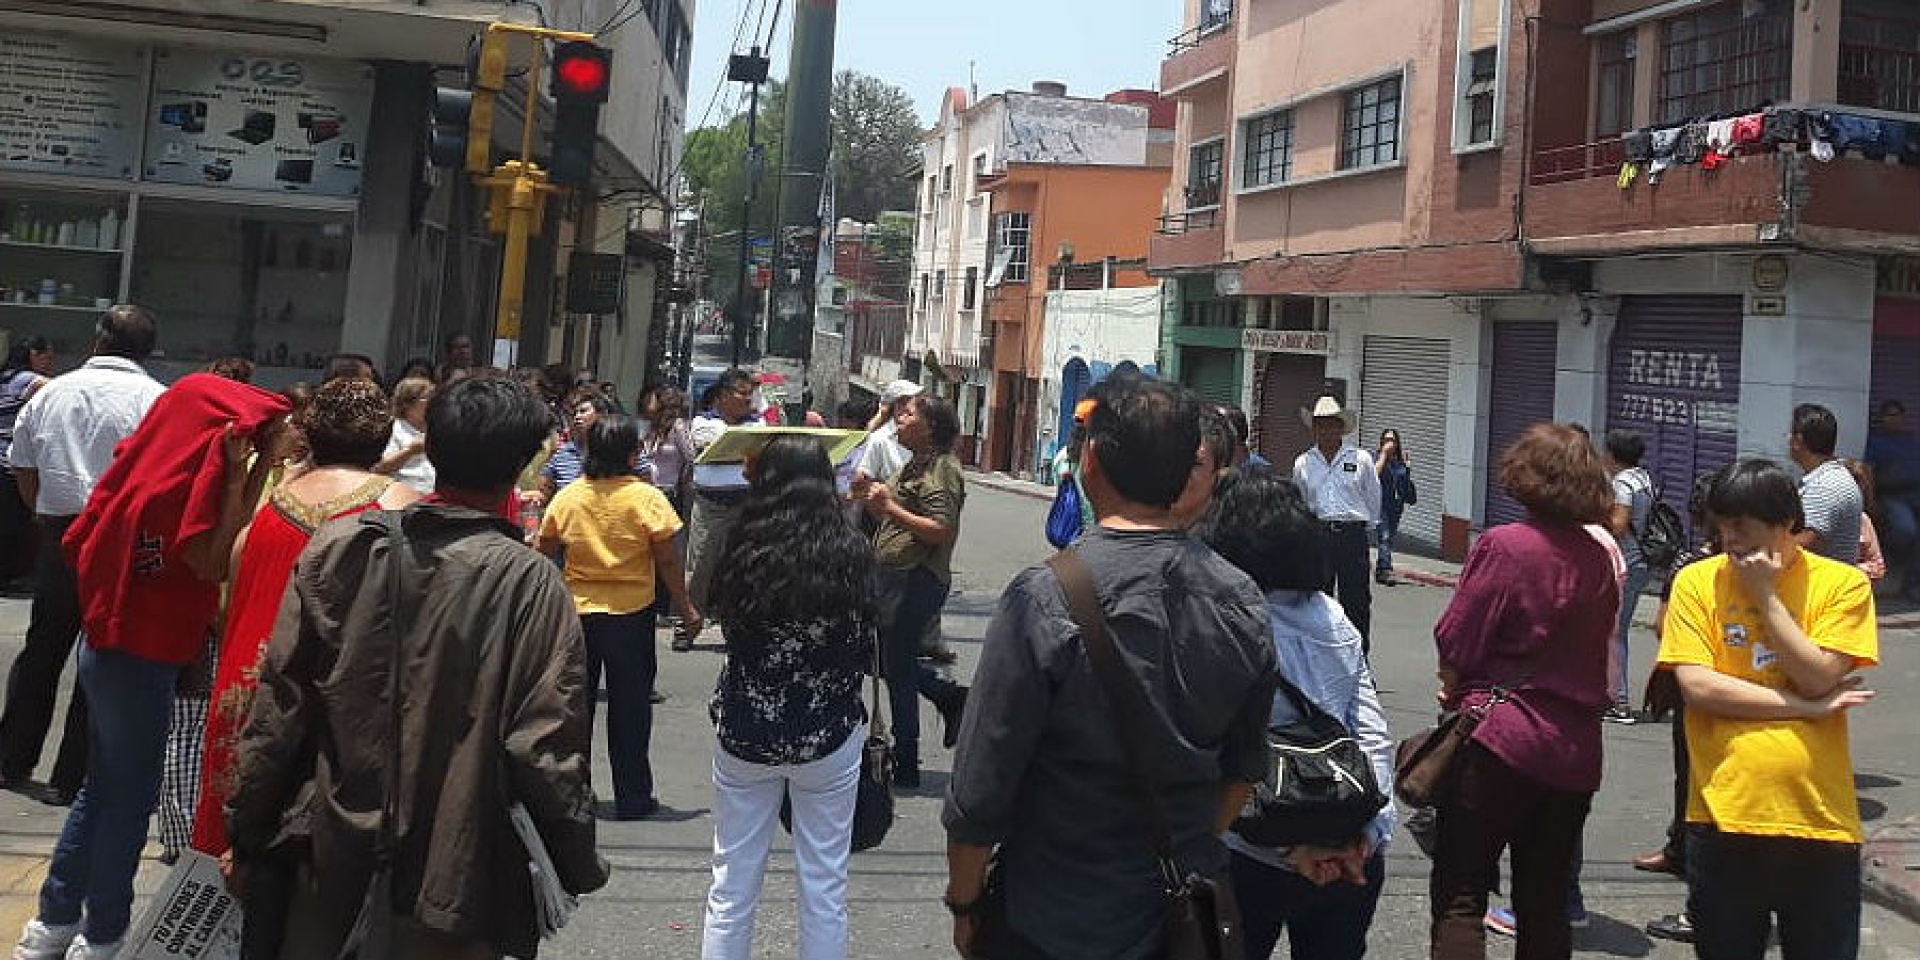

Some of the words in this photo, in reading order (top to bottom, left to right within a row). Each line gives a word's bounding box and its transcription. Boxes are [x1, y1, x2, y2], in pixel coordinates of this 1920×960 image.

[1629, 349, 1722, 389] RENTA
[165, 883, 219, 954] CONTRIBUIR
[195, 895, 231, 943] CAMBIO
